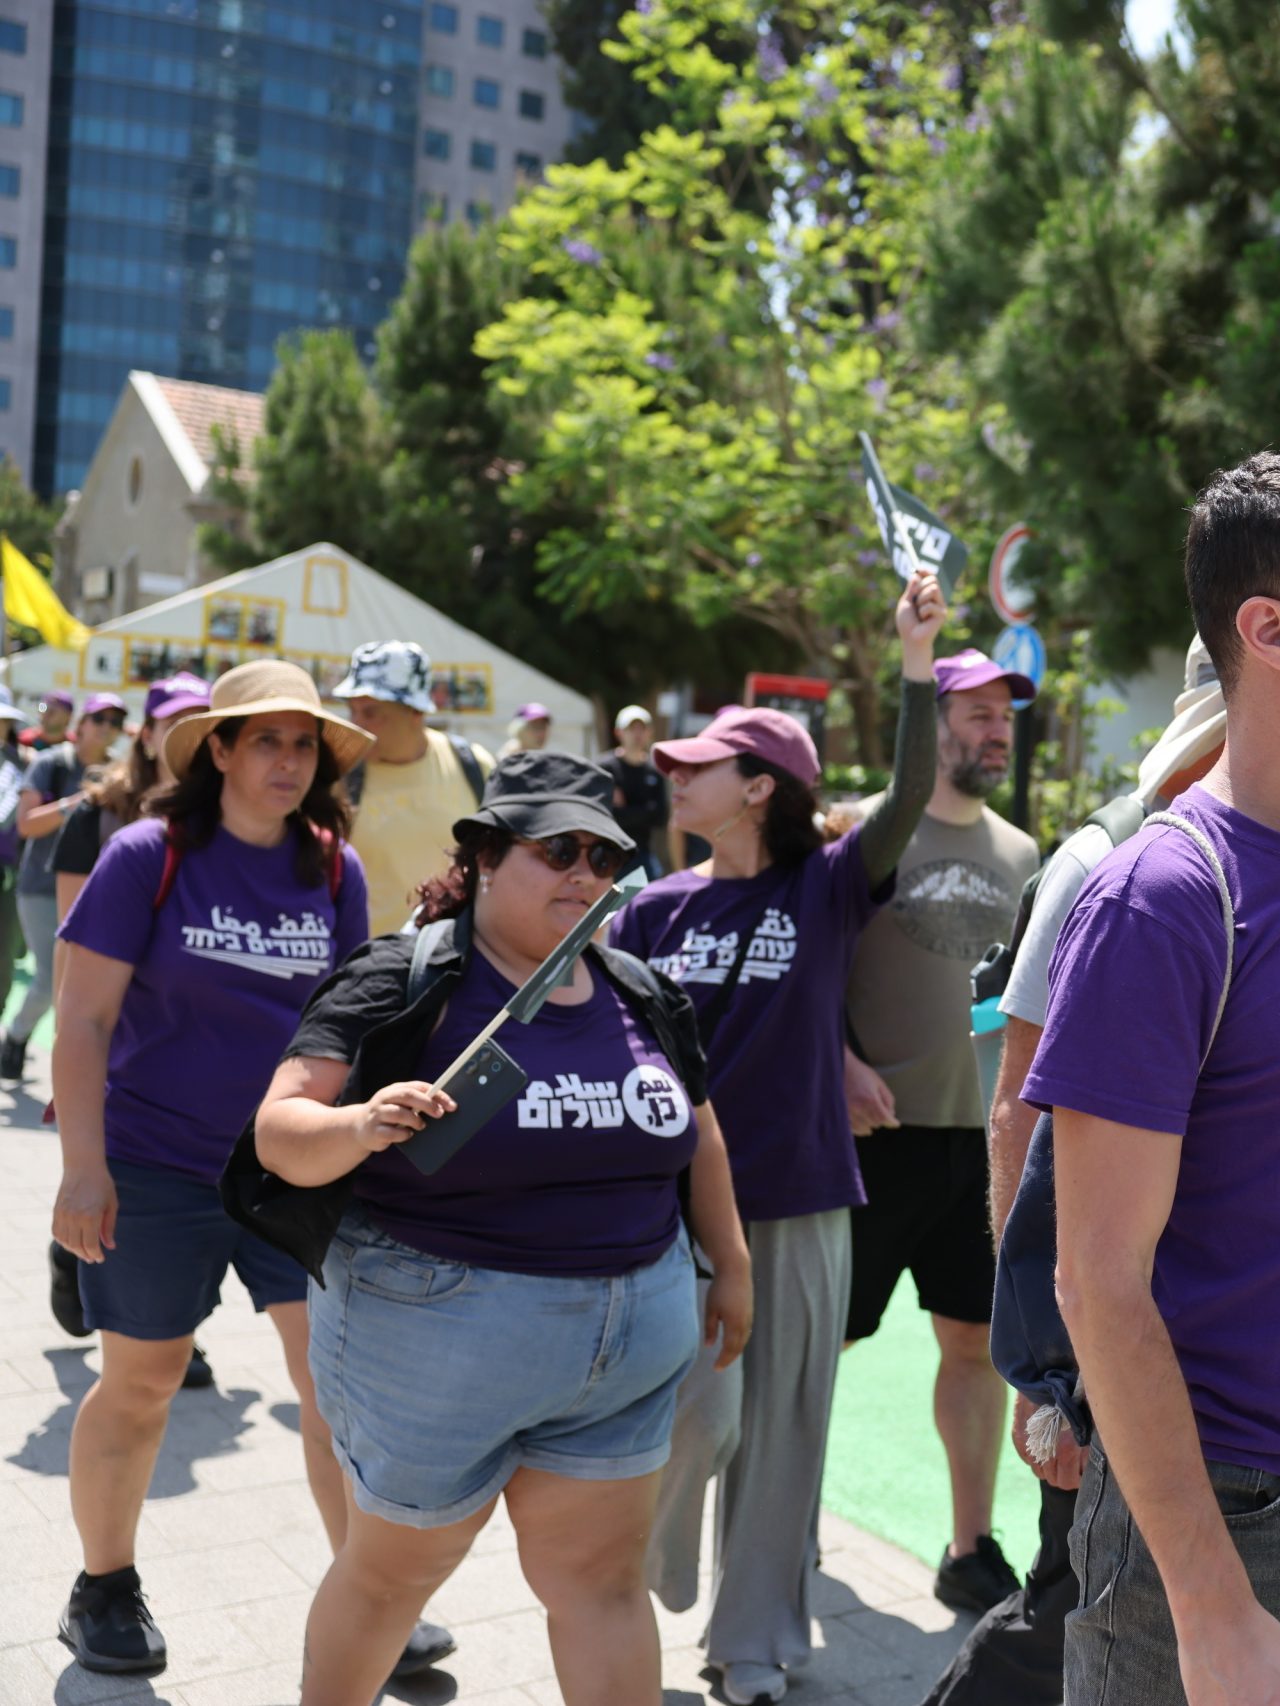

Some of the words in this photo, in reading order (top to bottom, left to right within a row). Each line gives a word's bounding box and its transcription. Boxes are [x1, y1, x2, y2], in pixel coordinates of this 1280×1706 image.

[754, 908, 796, 939] نق
[181, 925, 242, 951] ביחד
[247, 937, 329, 959] עומדים
[526, 1073, 618, 1101] سلام
[637, 1074, 673, 1101] نعم
[517, 1095, 625, 1129] שלום
